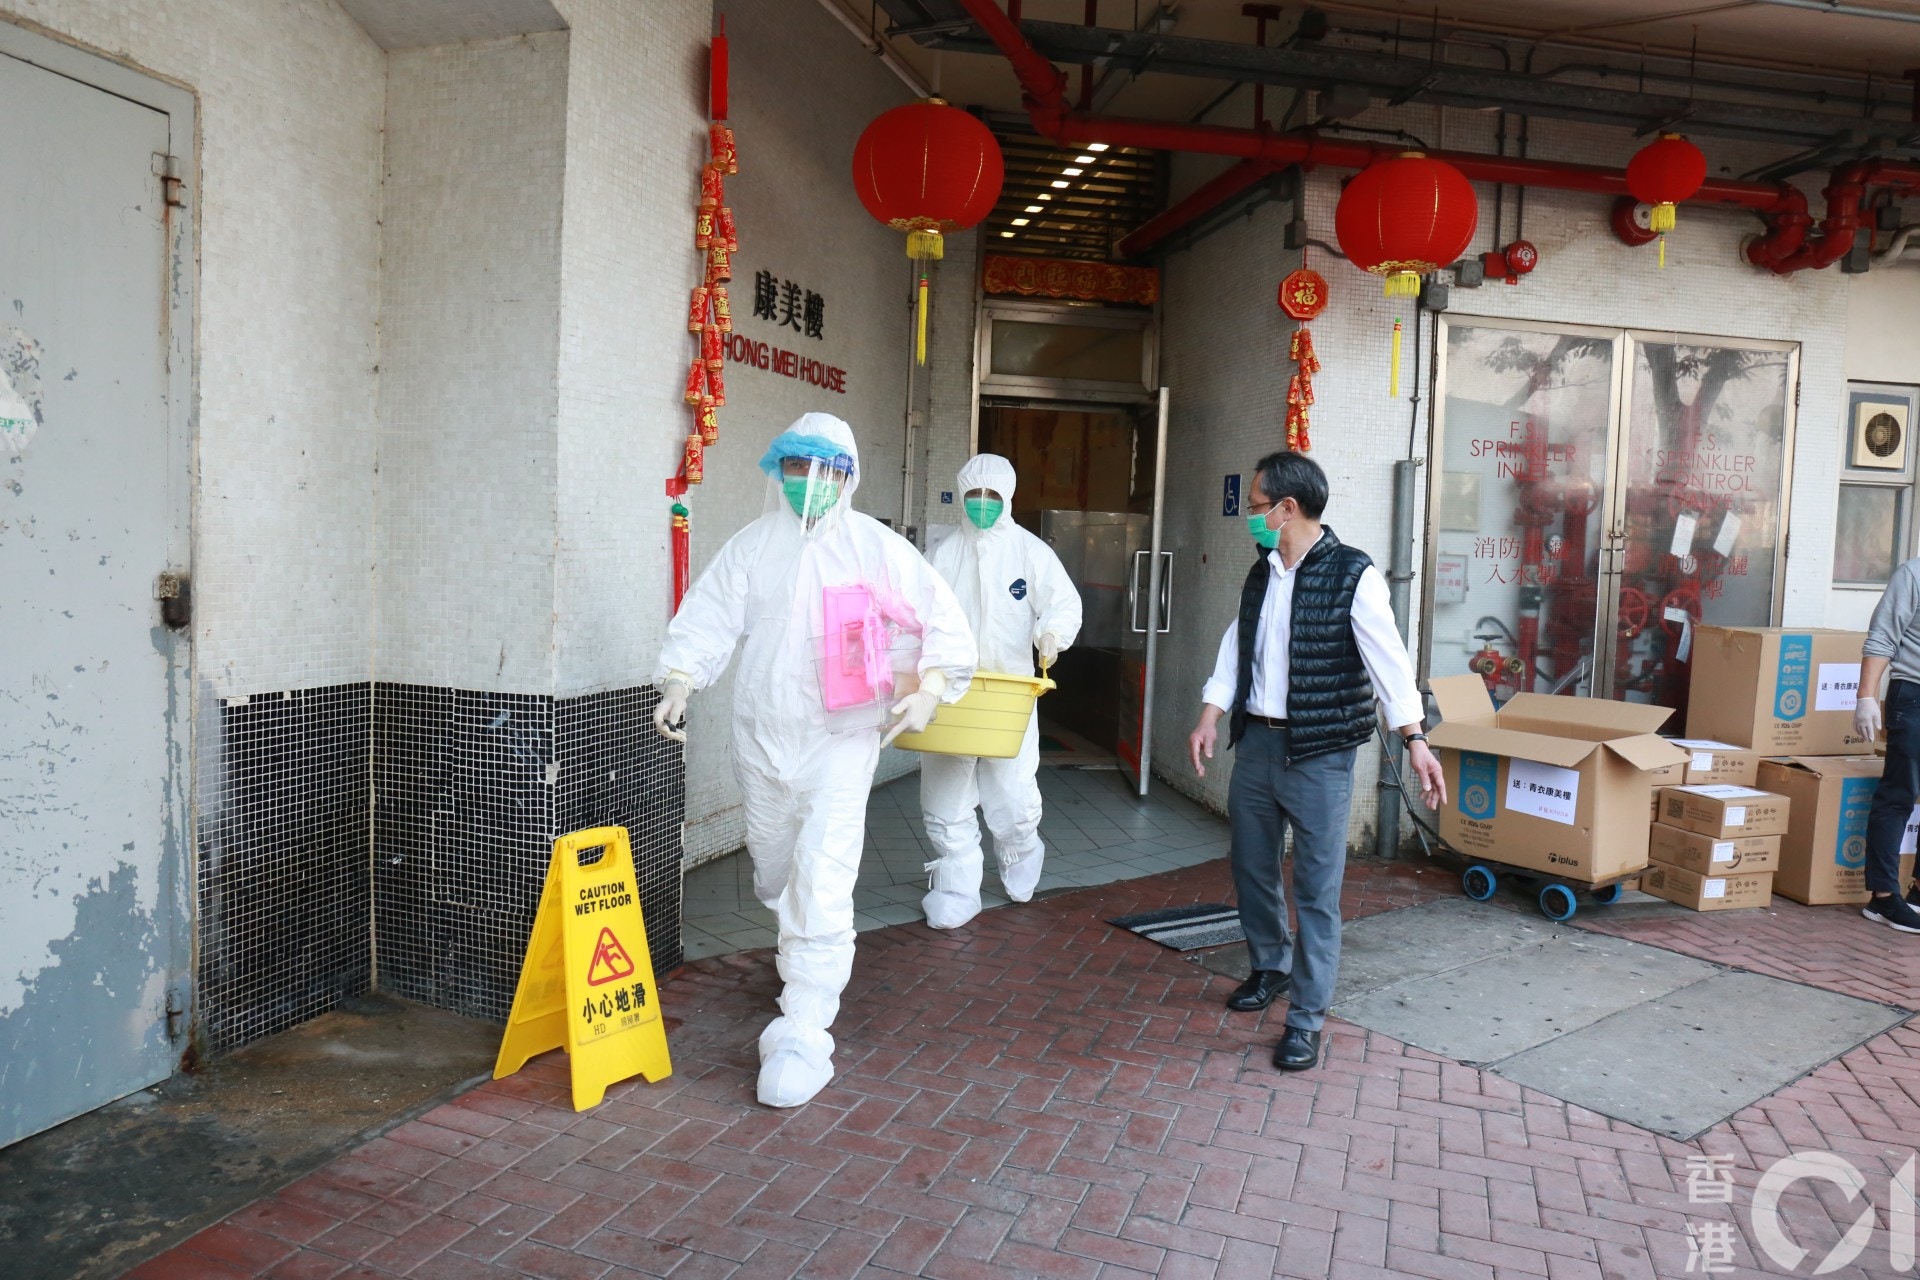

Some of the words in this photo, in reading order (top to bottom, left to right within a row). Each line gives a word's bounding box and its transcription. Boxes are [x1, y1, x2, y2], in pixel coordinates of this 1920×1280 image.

[1293, 281, 1319, 306] 福
[752, 270, 825, 341] 康美樓
[721, 332, 770, 370] HONG
[771, 347, 799, 379] MEI
[800, 356, 847, 394] HOUSE
[1470, 438, 1577, 463] SPRINKLER
[1693, 432, 1721, 451] F.S.
[1497, 461, 1550, 481] INLET
[1655, 450, 1756, 472] SPRINKLER
[1656, 469, 1753, 492] CONTROL
[1558, 855, 1579, 867] iplus
[579, 881, 625, 901] CAUTION
[574, 901, 597, 916] WET
[599, 893, 632, 911] FLOOR
[582, 982, 646, 1024] 小心地滑
[593, 1023, 606, 1036] HD
